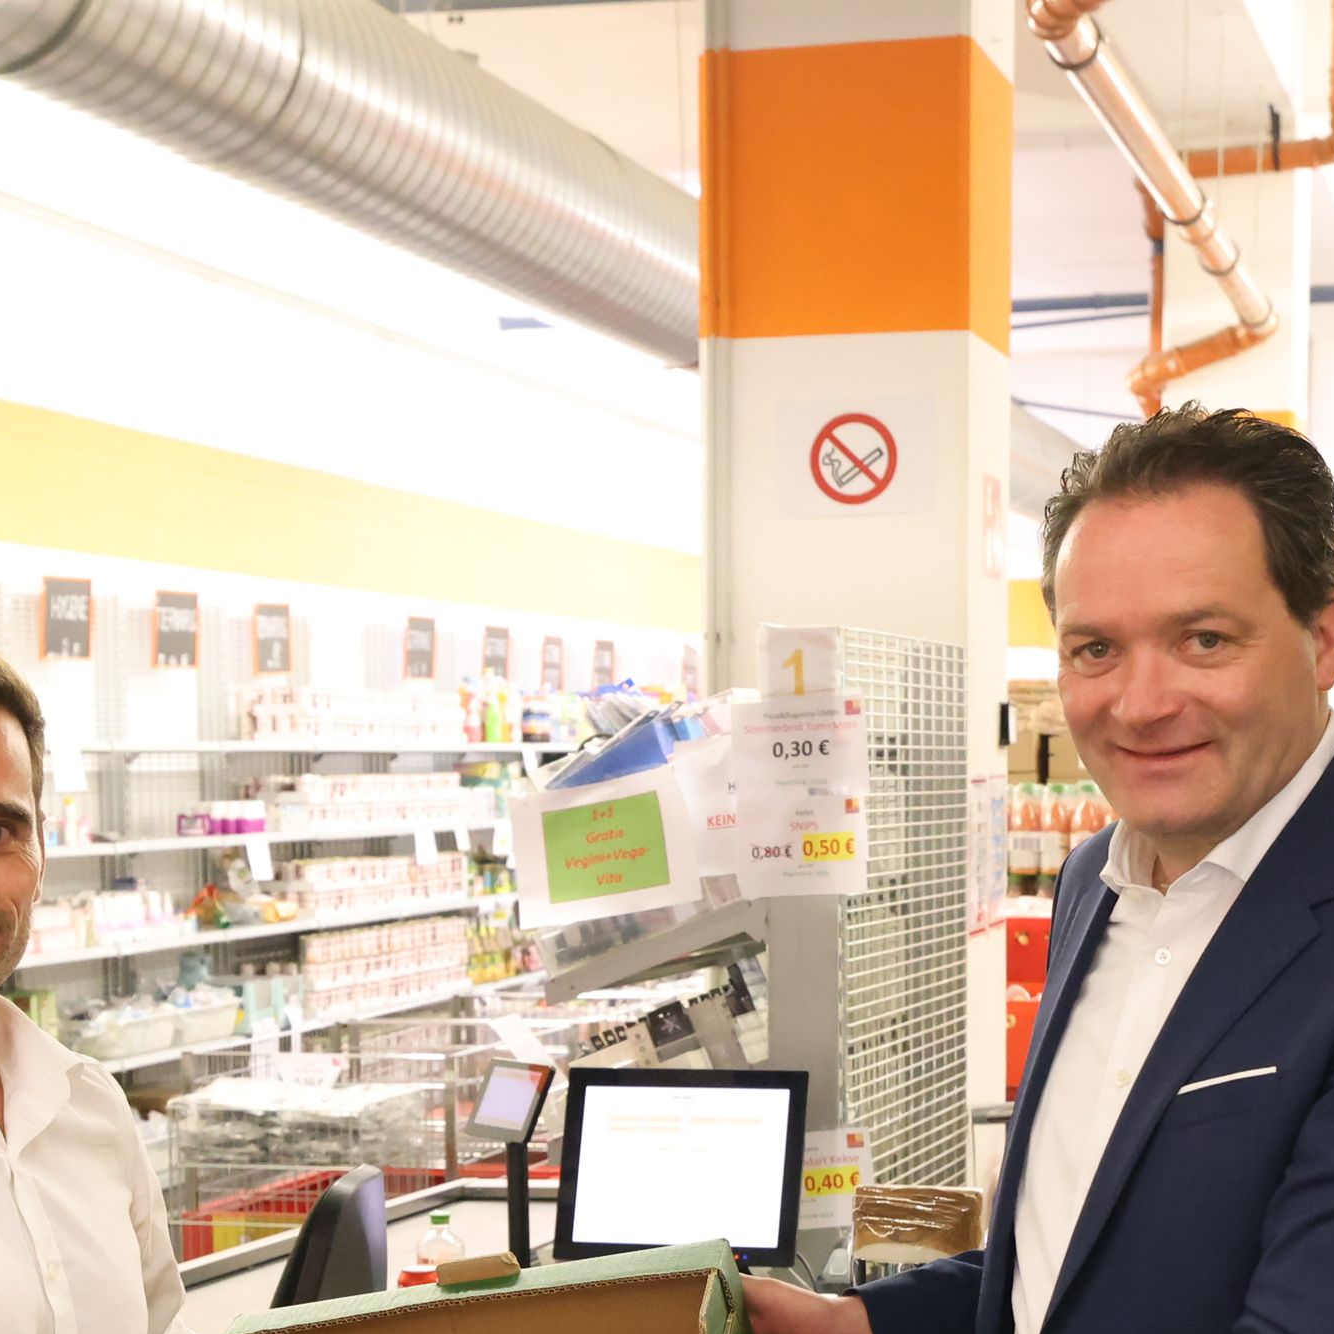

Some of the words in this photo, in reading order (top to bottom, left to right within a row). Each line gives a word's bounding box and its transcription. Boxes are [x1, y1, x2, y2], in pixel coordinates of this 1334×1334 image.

[782, 649, 805, 696] 1
[772, 740, 813, 760] 0,30
[819, 739, 830, 756] €
[592, 804, 614, 821] 1+1
[790, 821, 819, 832] SNIPS
[586, 828, 625, 844] Gratis
[803, 839, 840, 858] 0,50
[845, 838, 855, 854] €
[597, 873, 624, 885] Vita
[804, 1173, 844, 1194] 0,40
